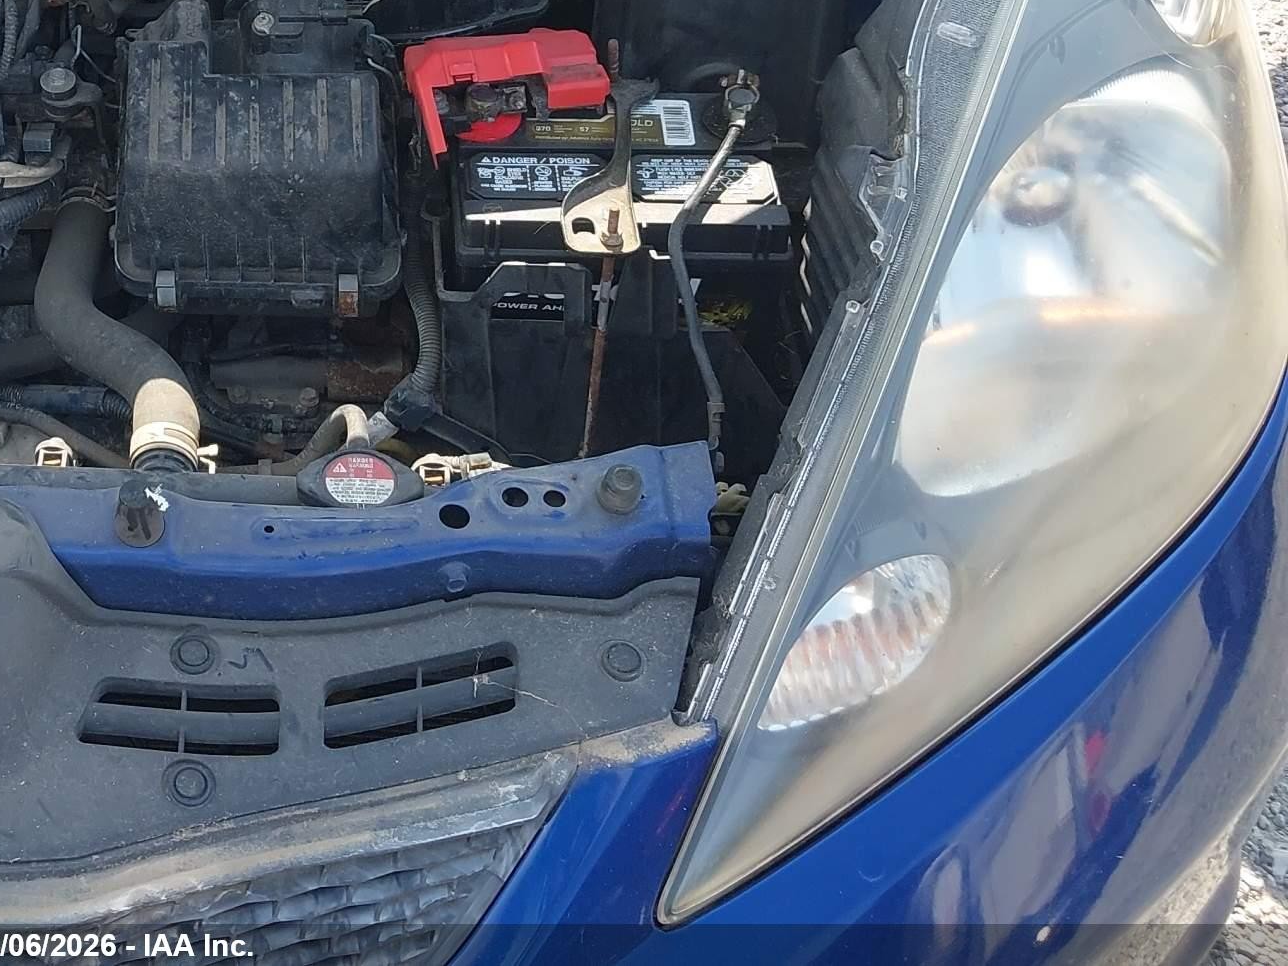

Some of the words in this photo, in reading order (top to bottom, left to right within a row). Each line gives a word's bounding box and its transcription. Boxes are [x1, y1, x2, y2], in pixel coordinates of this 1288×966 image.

[631, 118, 654, 127] OLD
[492, 156, 538, 164] DANGER
[549, 156, 591, 165] POISON
